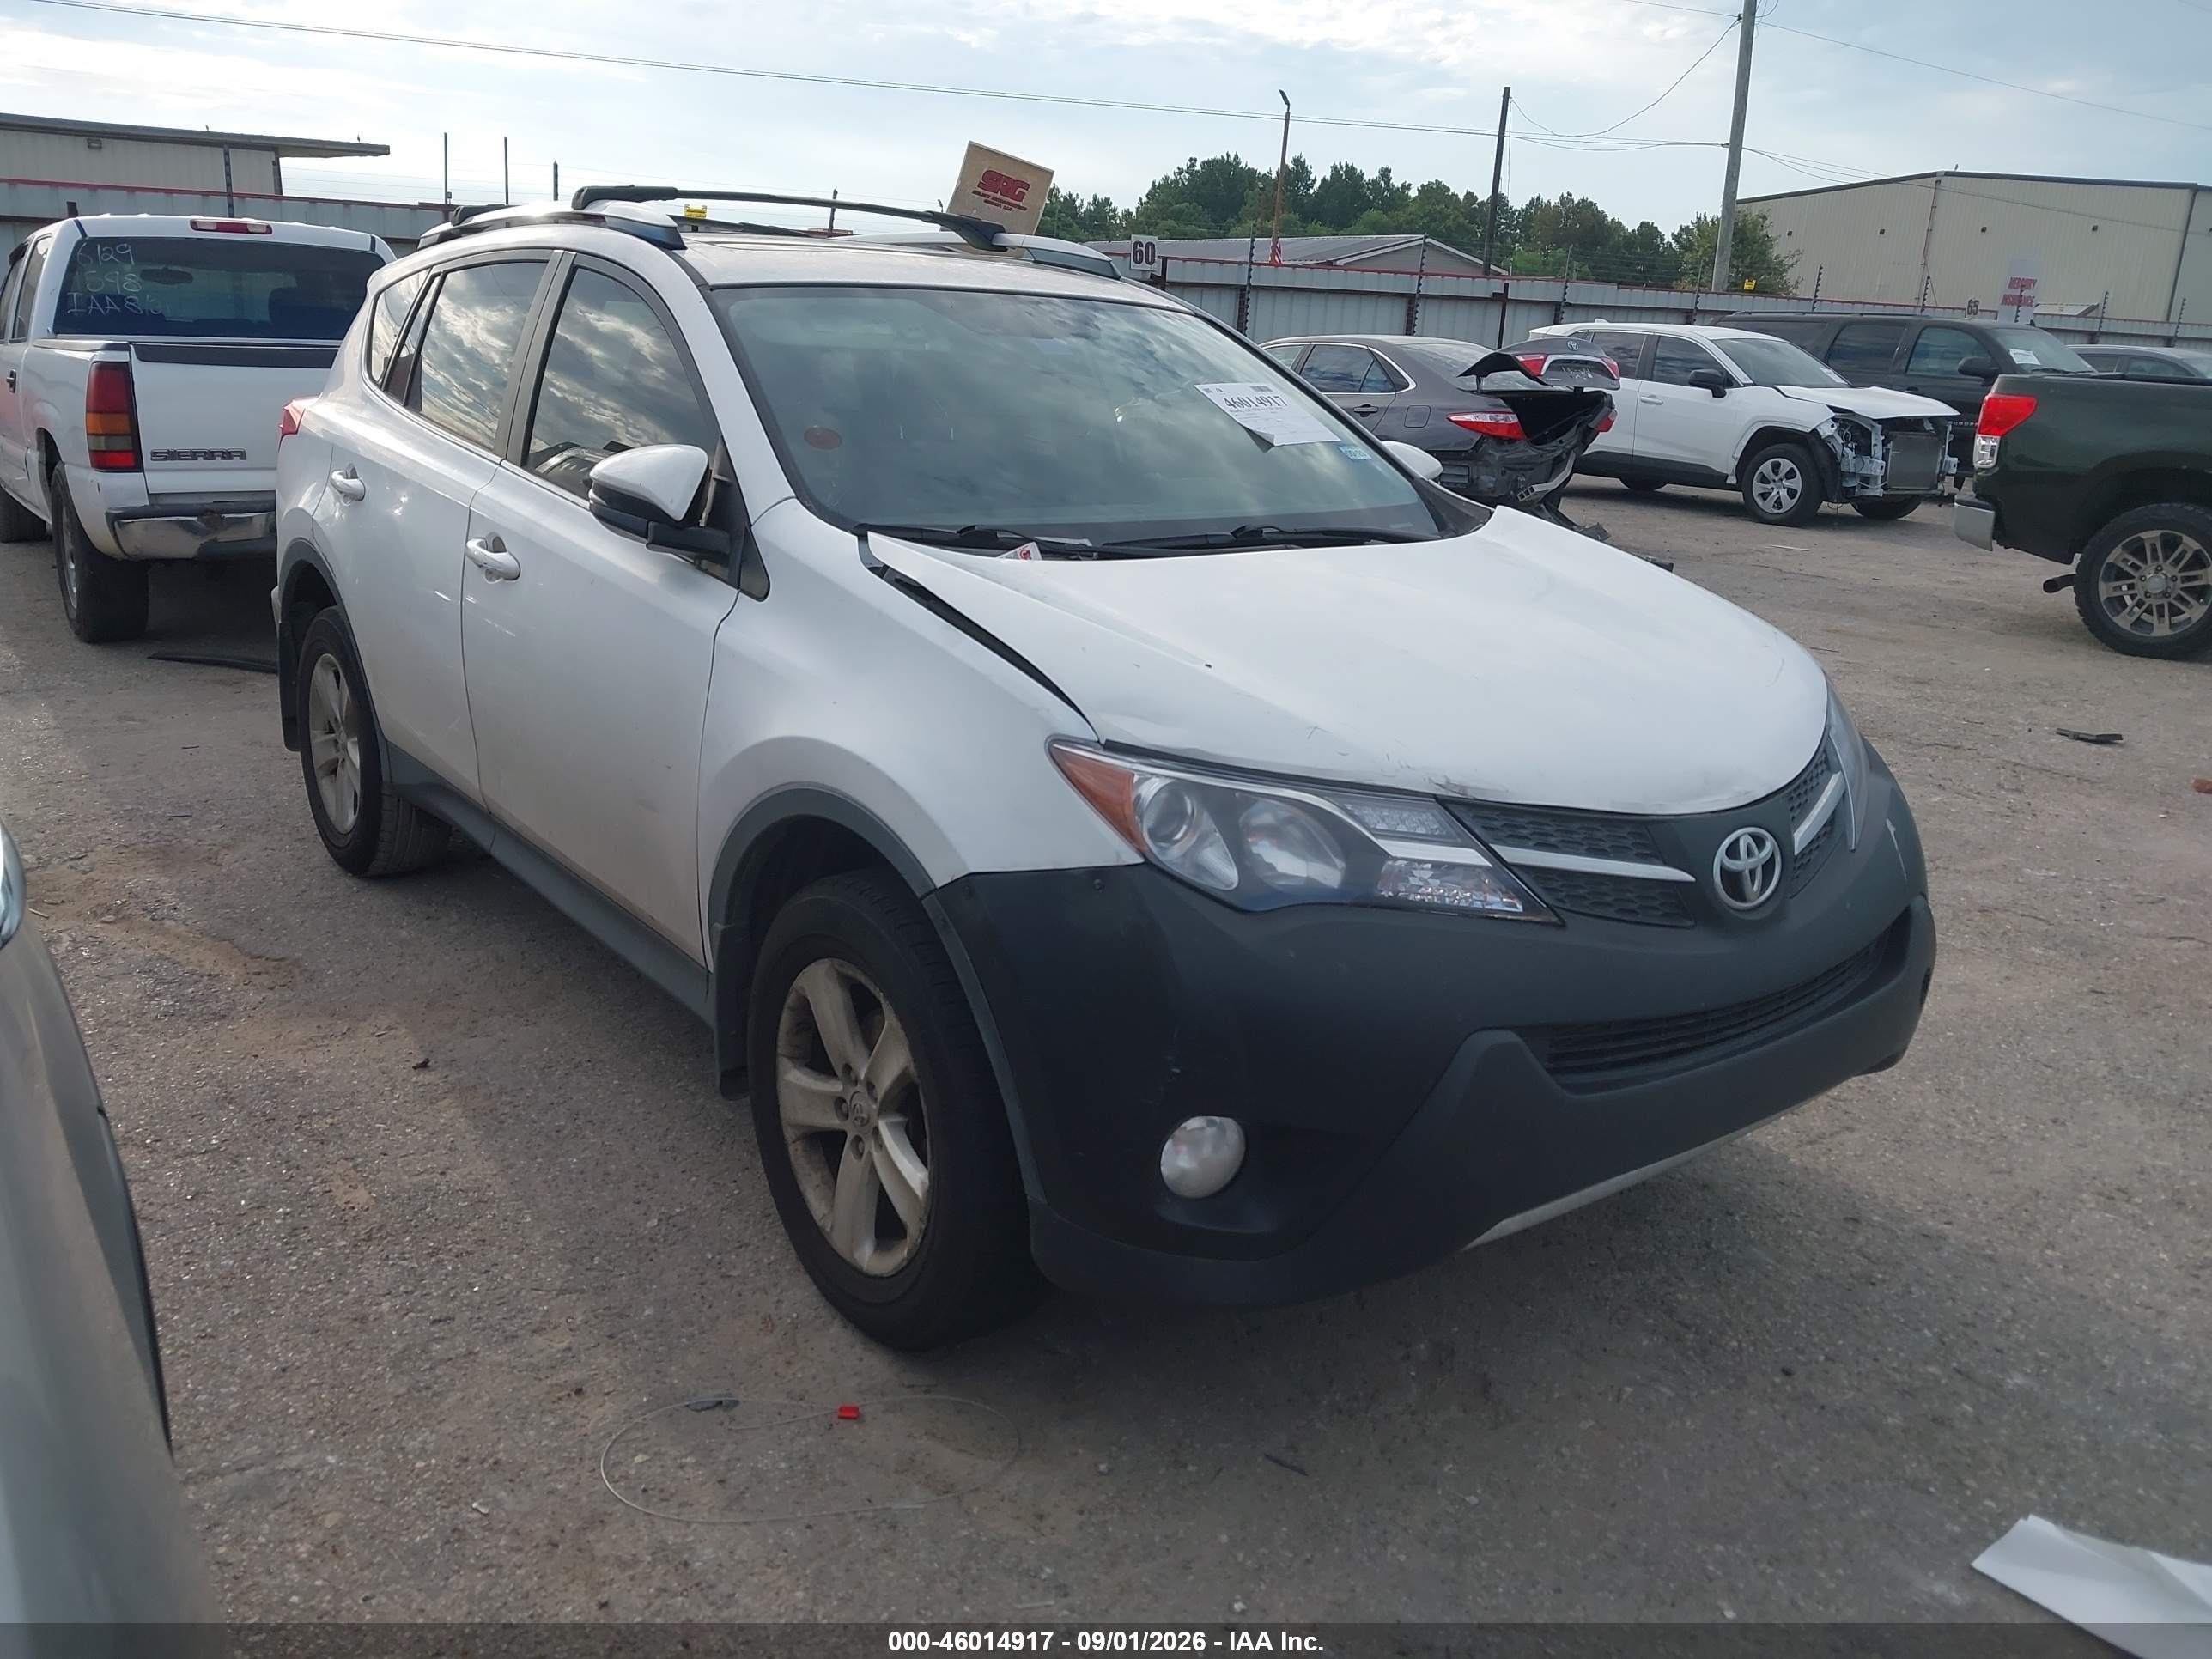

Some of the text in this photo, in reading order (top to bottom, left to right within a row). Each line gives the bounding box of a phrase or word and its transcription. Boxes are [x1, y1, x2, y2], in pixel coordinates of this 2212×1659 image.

[977, 170, 1030, 202] SRG
[76, 242, 136, 267] 6129
[1133, 240, 1156, 265] 60
[1966, 299, 1979, 316] 65
[1224, 395, 1288, 409] 46014917
[150, 447, 246, 462] SIERRA
